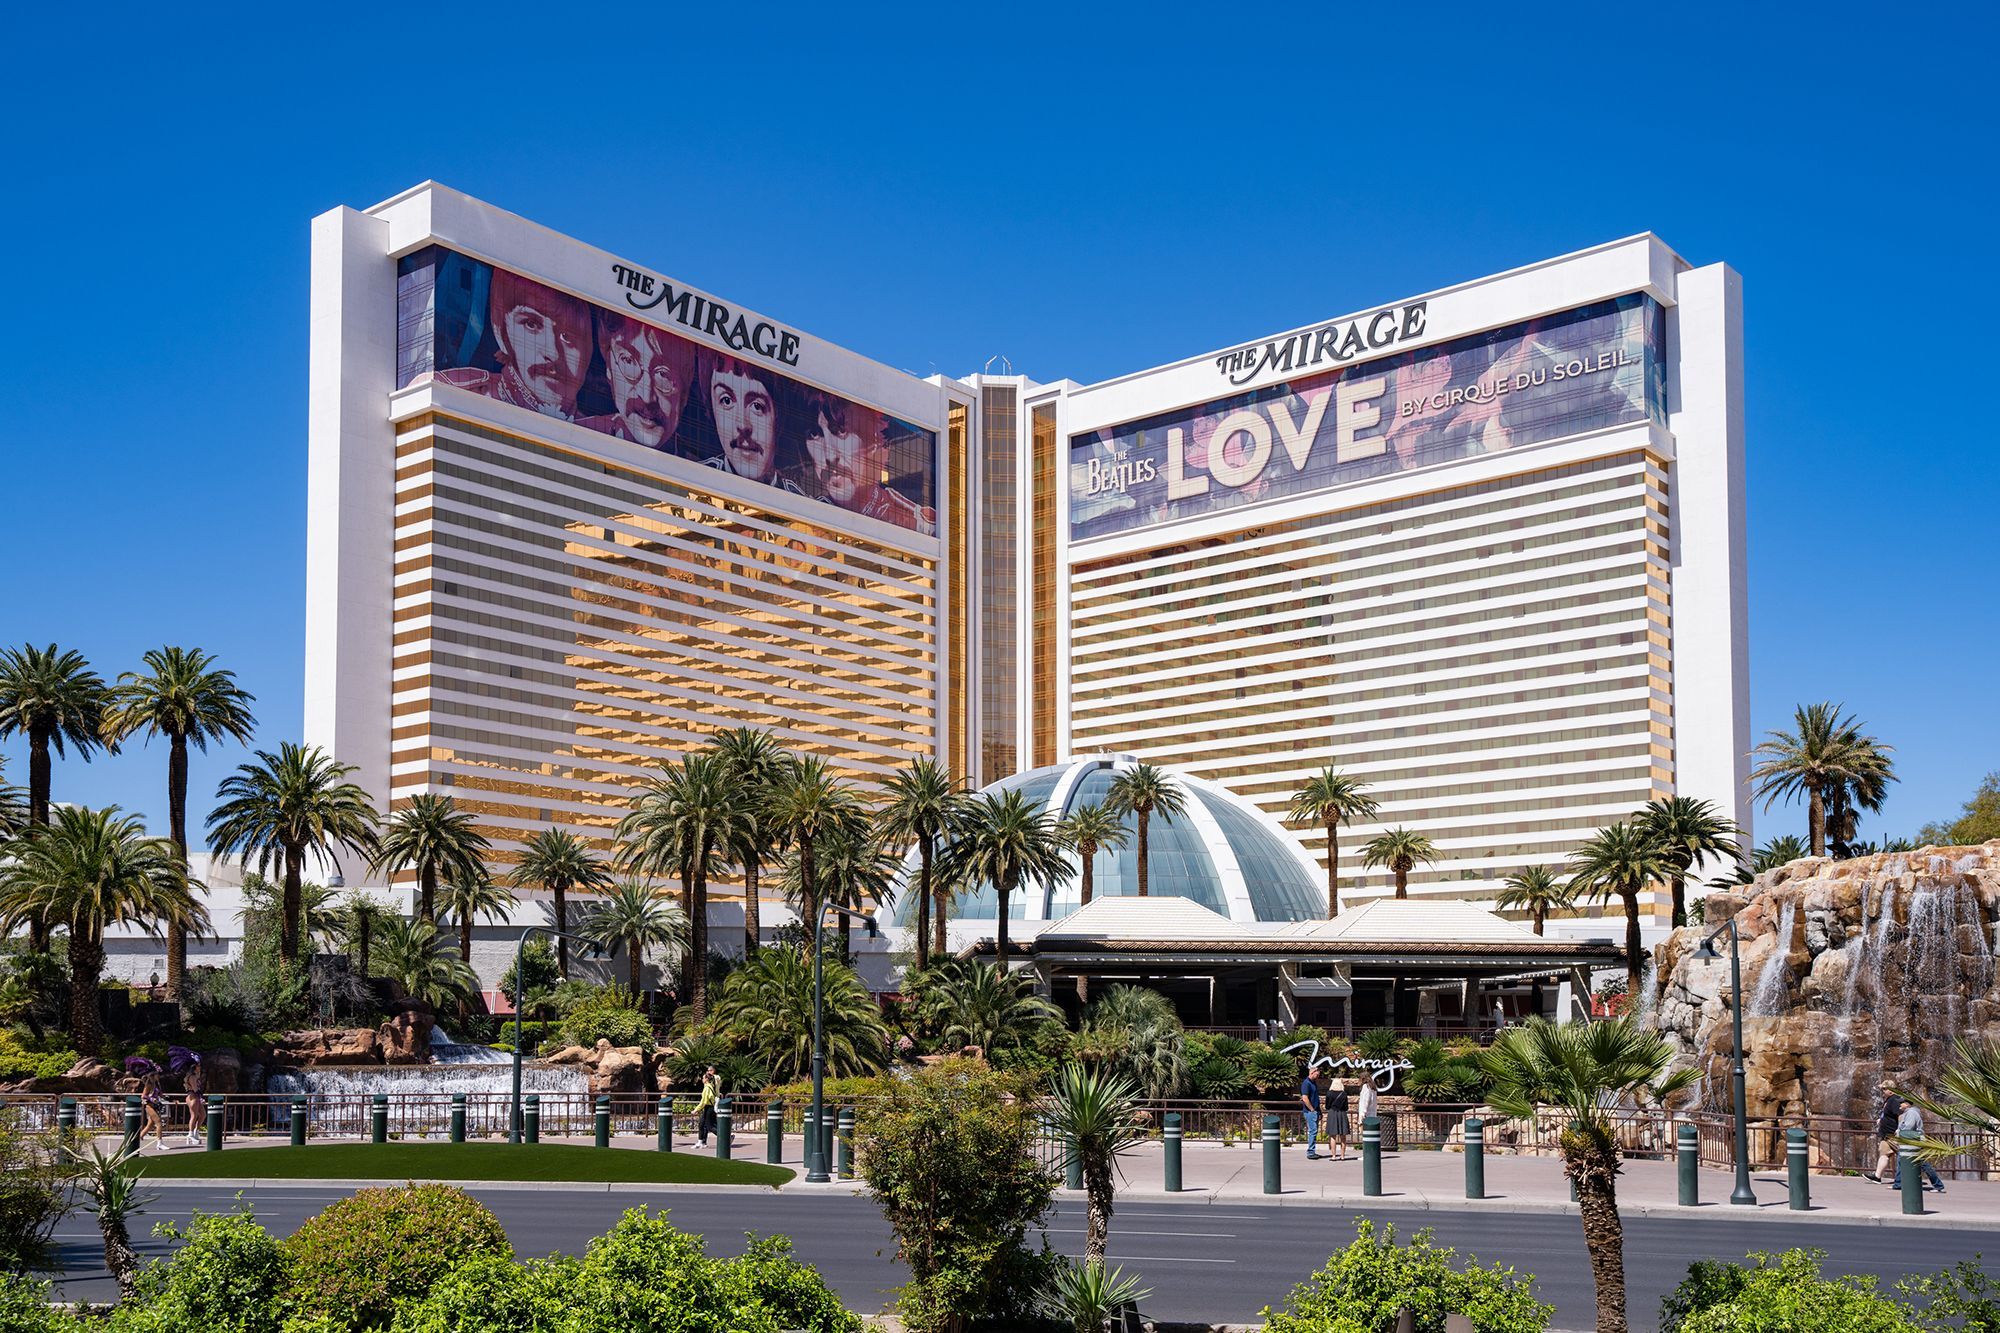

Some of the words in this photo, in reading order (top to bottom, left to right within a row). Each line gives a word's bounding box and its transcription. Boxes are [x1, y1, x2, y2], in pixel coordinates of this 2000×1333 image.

[612, 264, 655, 296] THE
[625, 282, 801, 367] MIRAGE
[1229, 301, 1428, 387] MIRAGE
[1216, 348, 1257, 375] THE
[1401, 396, 1428, 417] BY
[1430, 378, 1509, 410] CIRQUE
[1515, 367, 1546, 391] DU
[1552, 349, 1632, 381] SOLEIL
[1113, 449, 1128, 462] THE
[1167, 376, 1388, 501] LOVE
[1087, 457, 1156, 495] BEATLES
